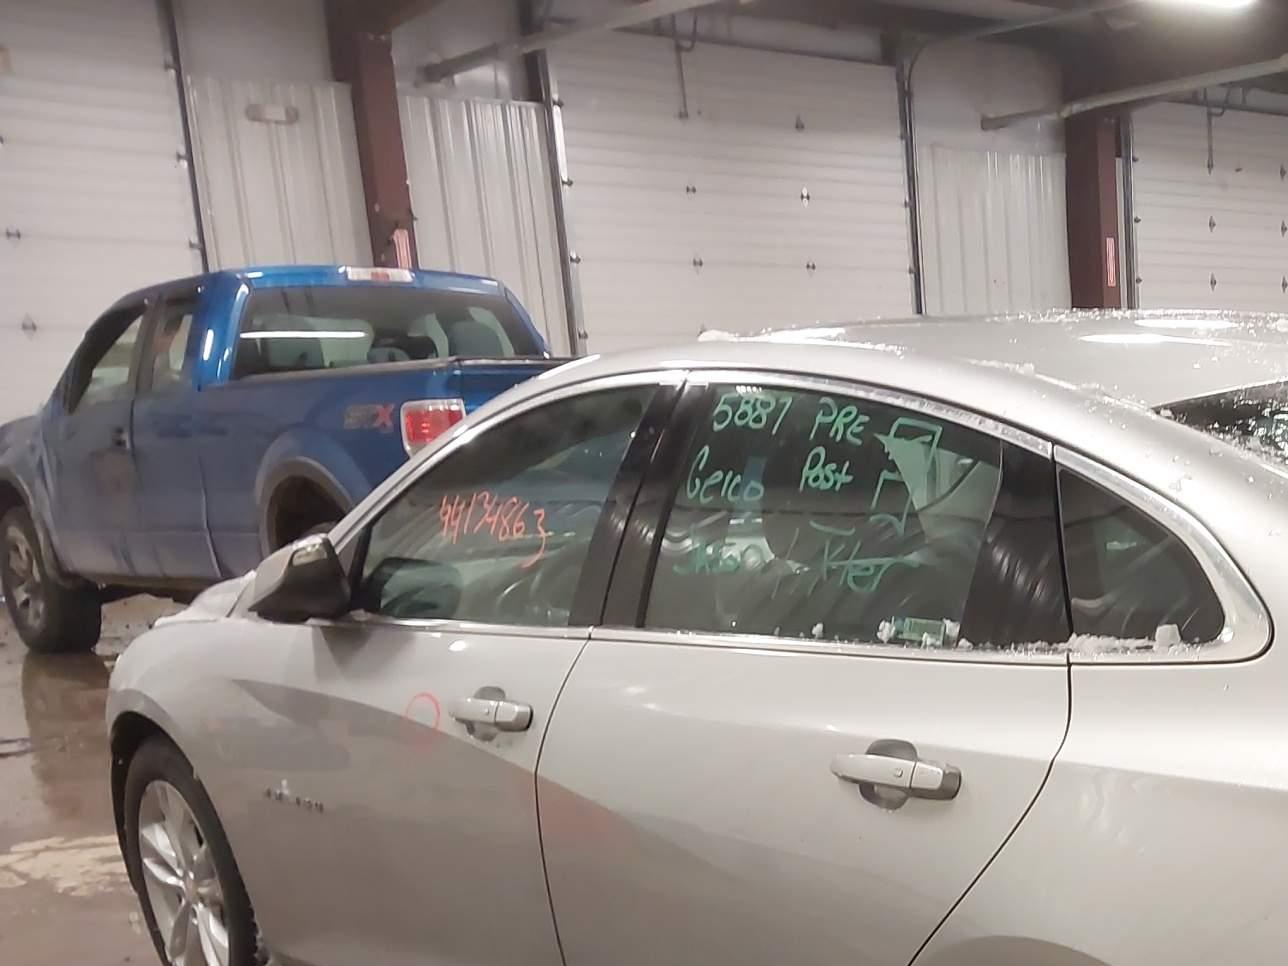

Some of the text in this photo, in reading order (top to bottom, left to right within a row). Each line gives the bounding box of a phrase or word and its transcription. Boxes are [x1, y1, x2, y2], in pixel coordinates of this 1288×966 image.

[712, 392, 871, 446] 5887 PRE
[799, 446, 854, 492] Post
[440, 490, 546, 569] 44134863
